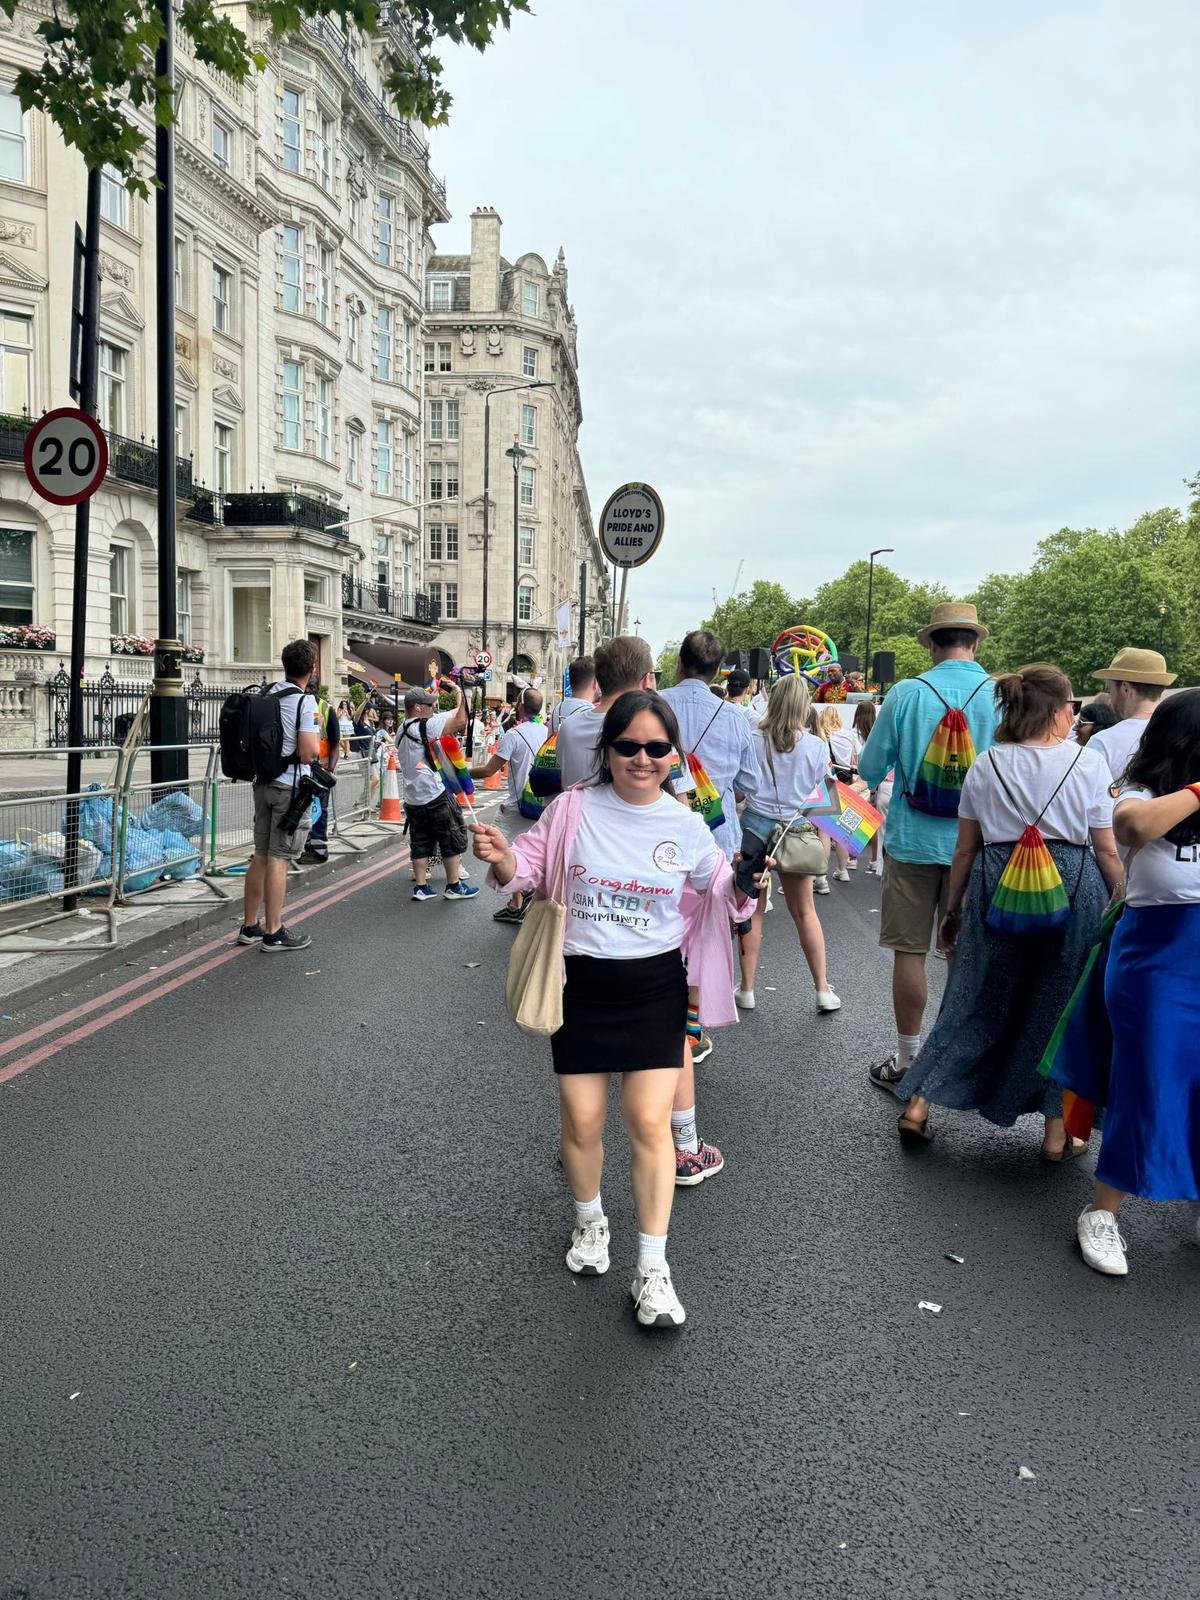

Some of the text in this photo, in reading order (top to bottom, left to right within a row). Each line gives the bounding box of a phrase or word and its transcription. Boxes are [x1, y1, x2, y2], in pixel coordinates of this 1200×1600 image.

[38, 437, 96, 477] 20
[613, 508, 651, 519] LLOYD'S
[606, 522, 655, 533] PRIDE AND
[613, 536, 644, 547] ALLIES
[477, 655, 490, 664] 20
[569, 864, 675, 896] Rongdhanu
[572, 891, 657, 913] ASIAN LGBT
[570, 907, 650, 927] COMMUNITY
